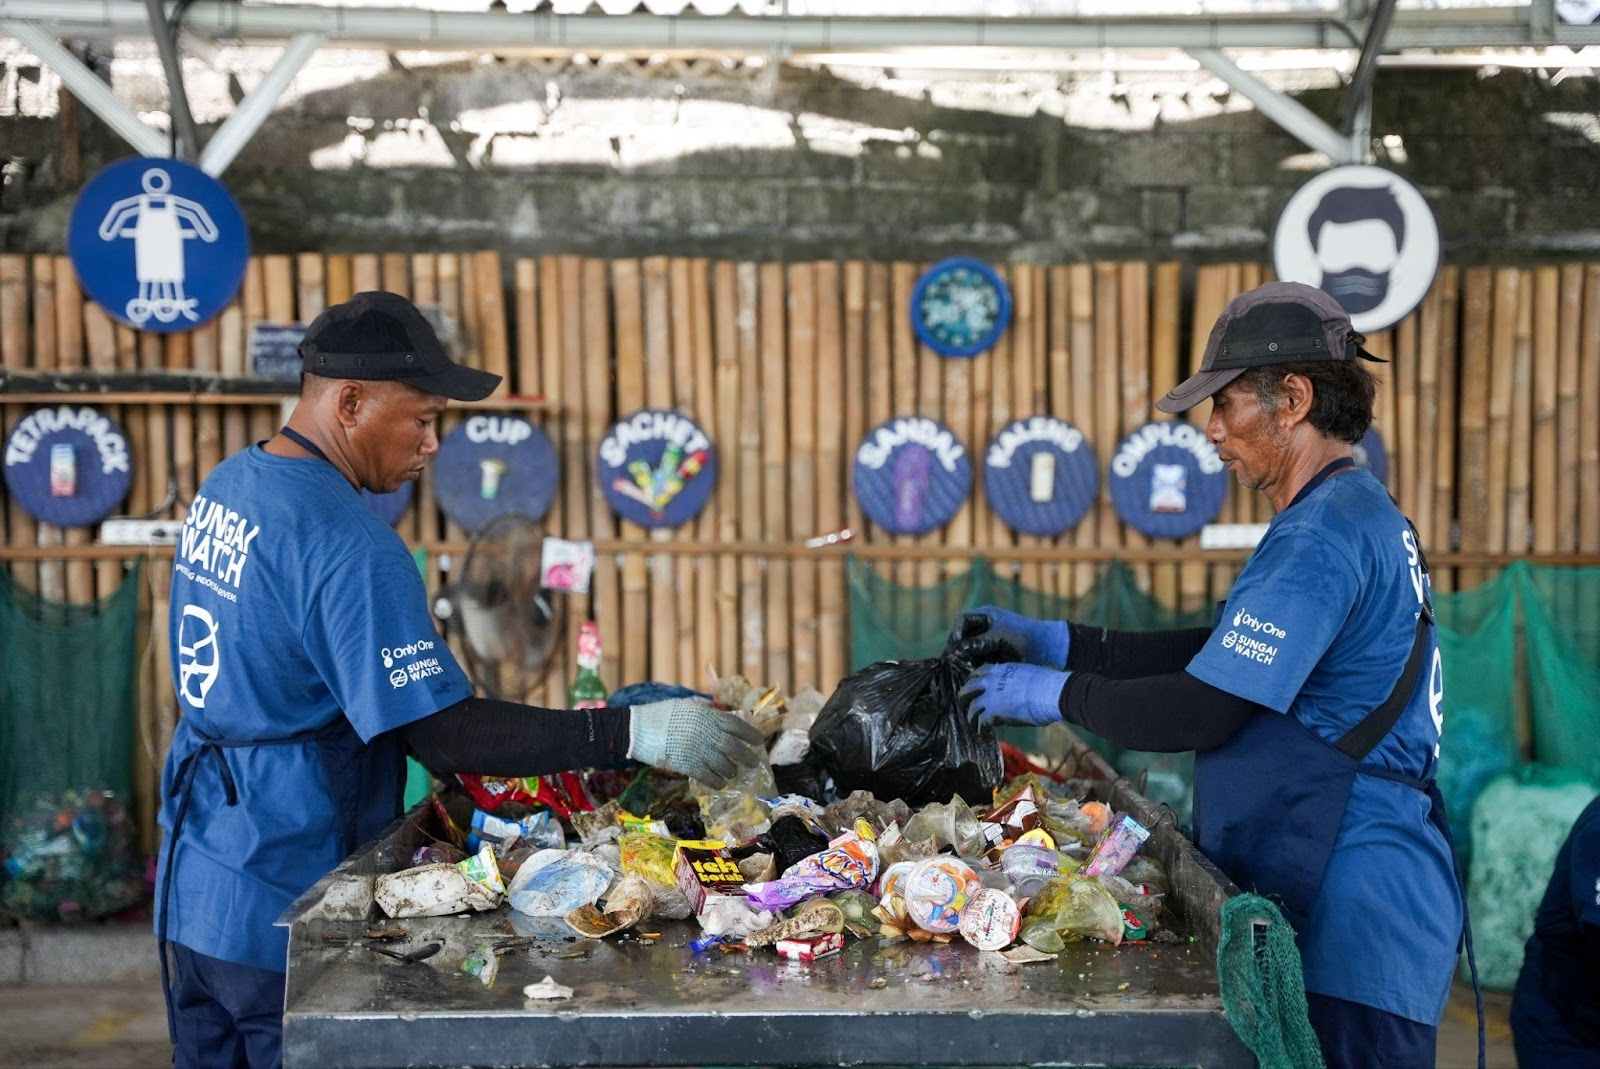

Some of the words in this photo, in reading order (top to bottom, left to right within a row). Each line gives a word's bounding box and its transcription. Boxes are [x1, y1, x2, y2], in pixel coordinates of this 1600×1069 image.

[5, 404, 129, 475] TETRAPACK
[466, 415, 532, 446] CUP
[600, 412, 709, 468] SACHET
[858, 417, 964, 472] SANDAL
[986, 416, 1082, 469] KALENG
[185, 494, 260, 555] SUNGAI
[181, 523, 247, 588] WATCH
[1242, 613, 1263, 632] Only
[1262, 622, 1287, 639] One
[393, 644, 418, 659] Only
[417, 640, 434, 651] One
[1234, 642, 1274, 665] WATCH
[1238, 634, 1278, 657] SUNGAI
[407, 657, 439, 674] SUNGAI
[409, 665, 444, 682] WATCH
[692, 856, 740, 873] teh
